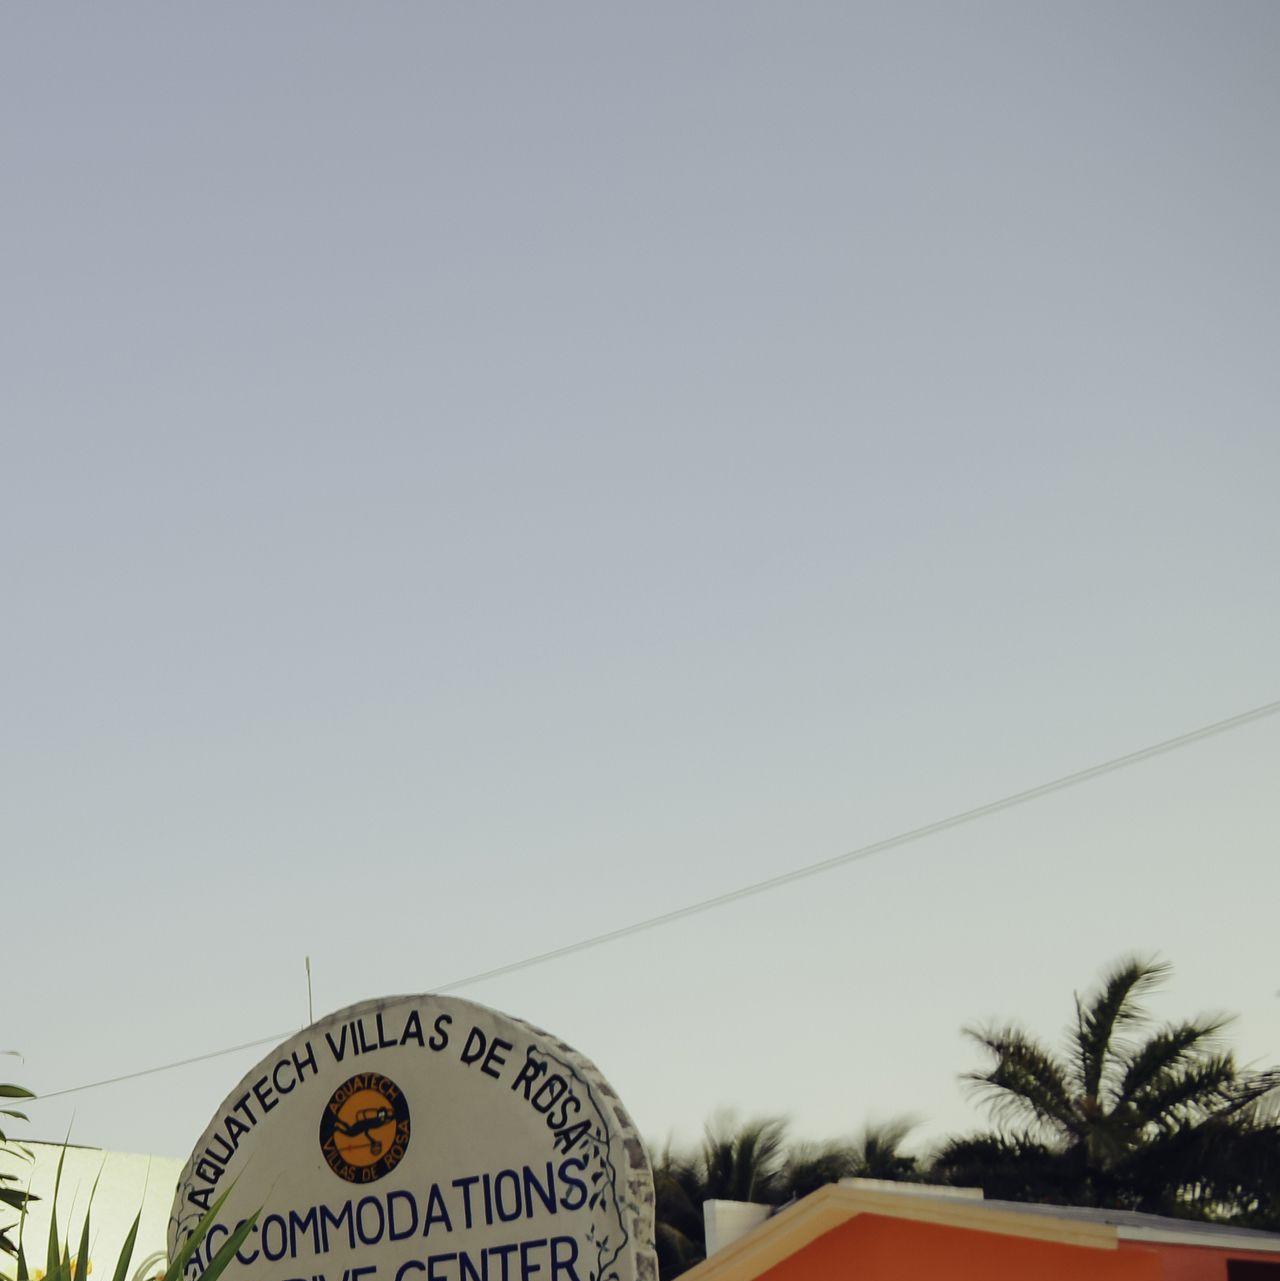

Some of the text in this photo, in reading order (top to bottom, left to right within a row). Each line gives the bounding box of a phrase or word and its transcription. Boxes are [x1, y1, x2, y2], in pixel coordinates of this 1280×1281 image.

[187, 1010, 592, 1212] AQUATECH VILLAS DE ROSA
[329, 1073, 399, 1115] AQUATECH
[323, 1121, 410, 1180] VILLAS DE ROSA
